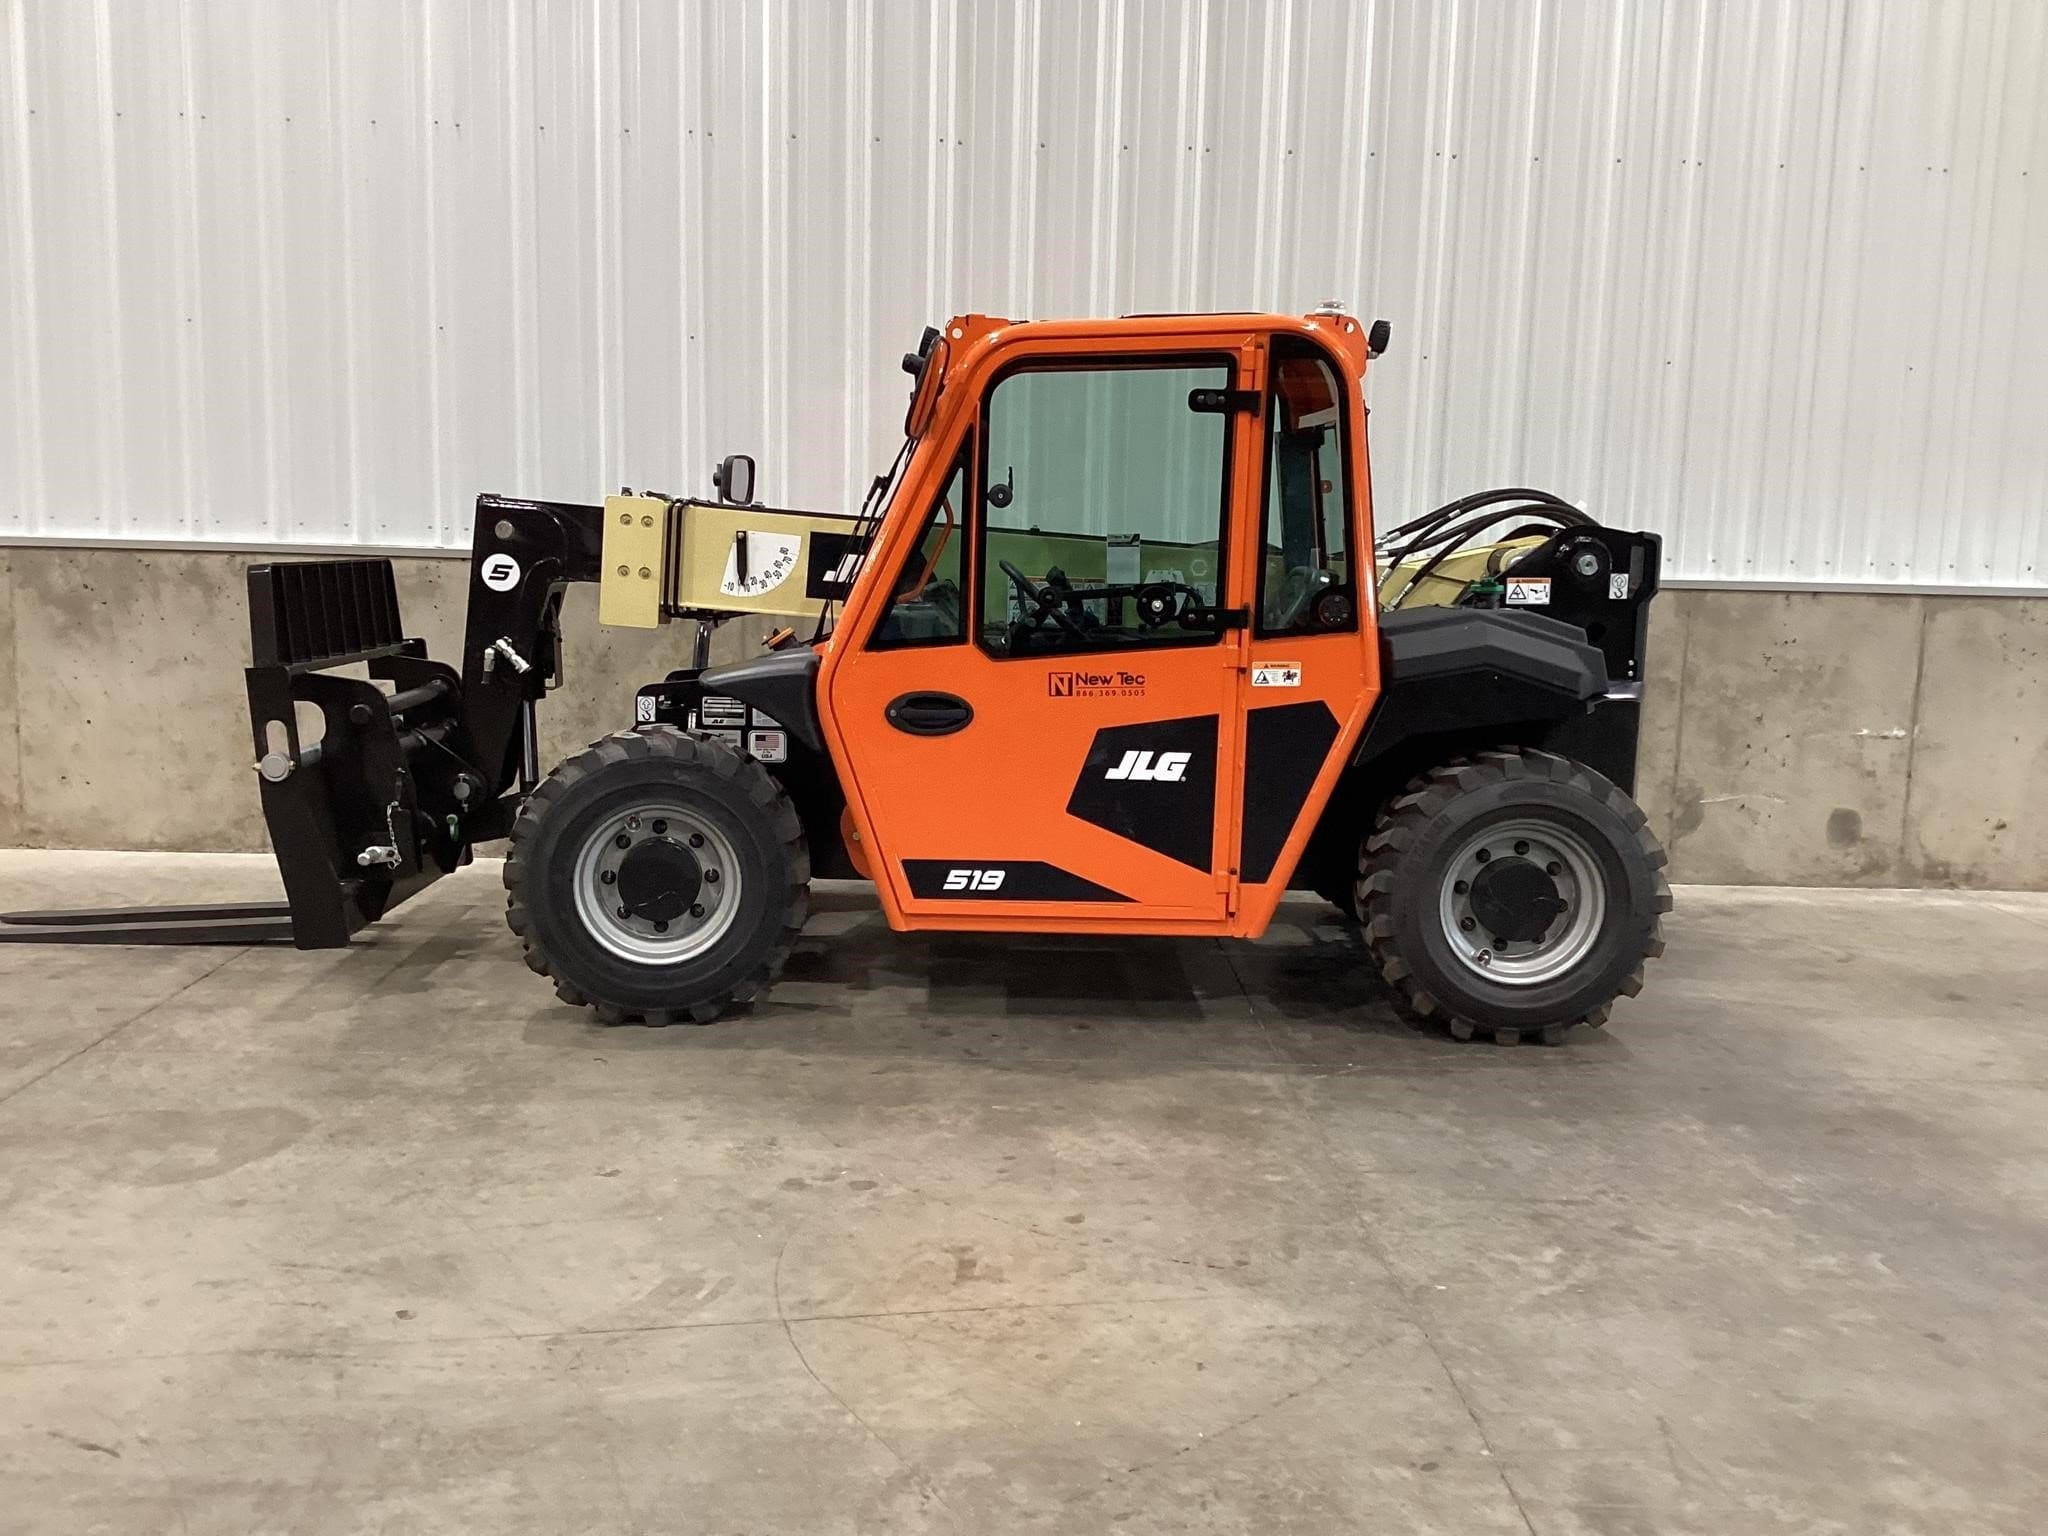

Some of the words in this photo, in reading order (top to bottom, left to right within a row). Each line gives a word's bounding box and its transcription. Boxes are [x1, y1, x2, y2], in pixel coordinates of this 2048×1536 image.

[1075, 672, 1114, 686] New
[1116, 671, 1145, 686] Tec
[1104, 750, 1193, 782] JLG
[943, 869, 1007, 891] 519
